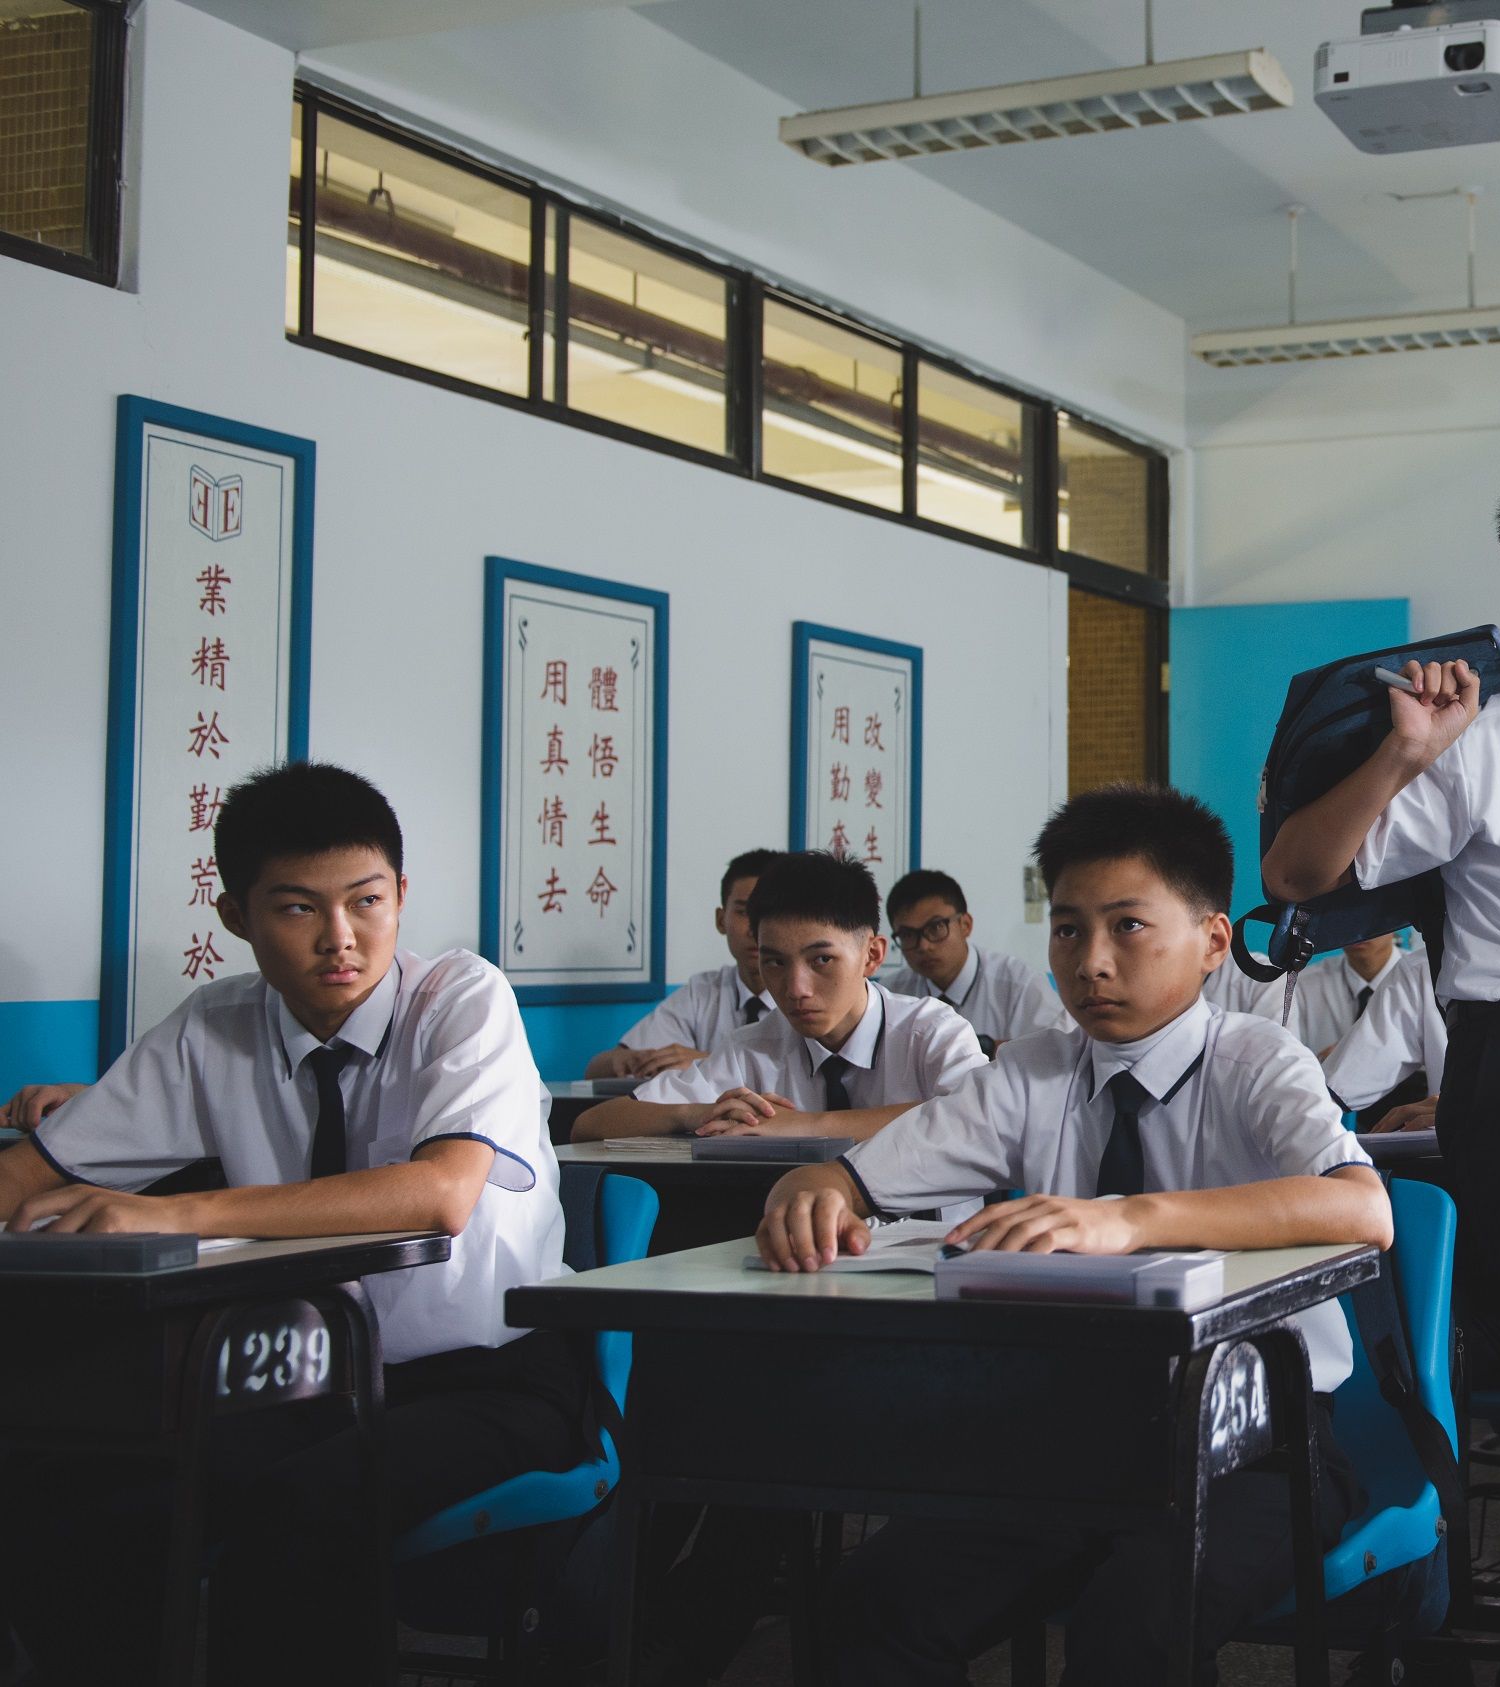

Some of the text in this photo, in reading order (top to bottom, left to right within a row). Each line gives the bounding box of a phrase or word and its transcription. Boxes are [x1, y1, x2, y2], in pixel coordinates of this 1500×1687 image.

[538, 660, 568, 913] 用真情去
[586, 666, 618, 918] 體悟生命
[863, 712, 885, 902] 改變生
[217, 1325, 331, 1395] 1239
[1210, 1360, 1267, 1450] 254
